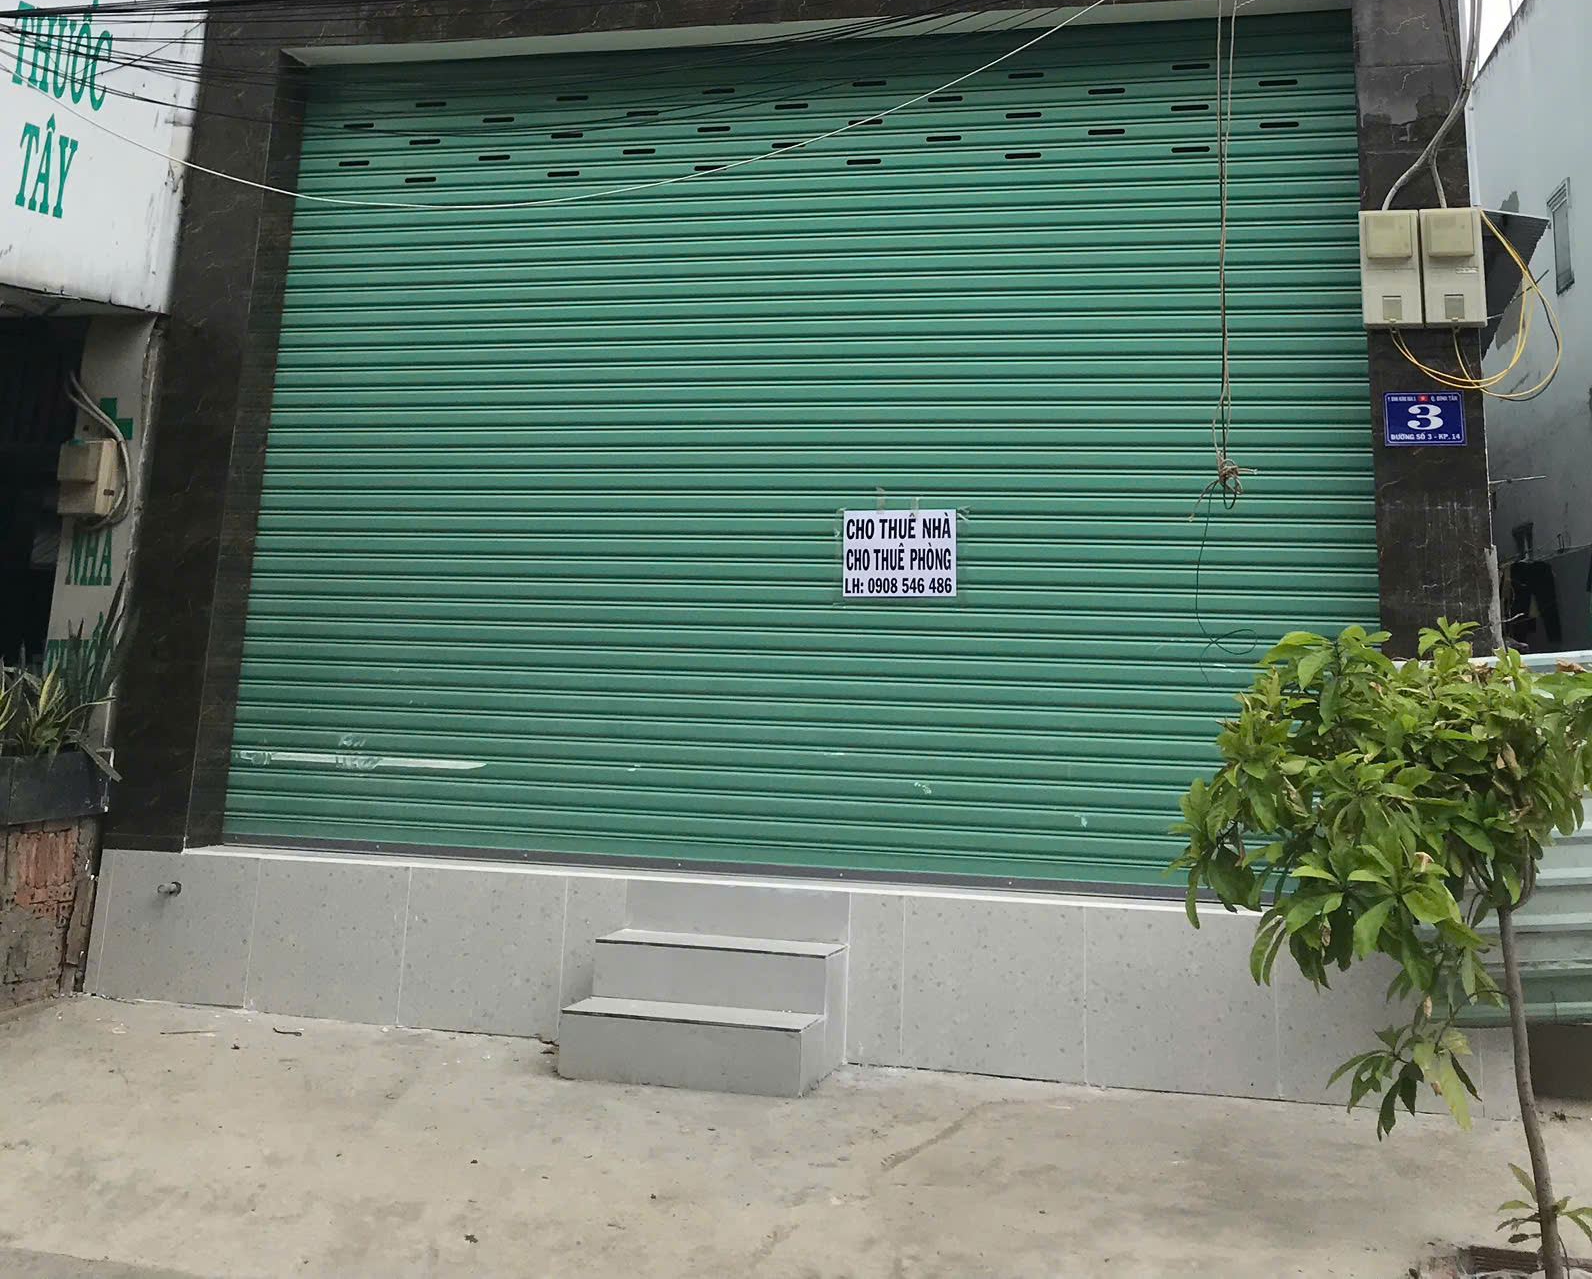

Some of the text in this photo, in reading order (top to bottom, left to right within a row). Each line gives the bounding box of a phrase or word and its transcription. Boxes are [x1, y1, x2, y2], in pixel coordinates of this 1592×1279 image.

[15, 113, 79, 218] TÂY
[1407, 404, 1444, 430] 3
[1415, 431, 1426, 440] SỐ
[846, 512, 951, 540] CHO THUÊ NHÀ
[846, 542, 952, 571] CHO THUÊ PHÒNG
[845, 577, 953, 594] LH: 0908 546 486
